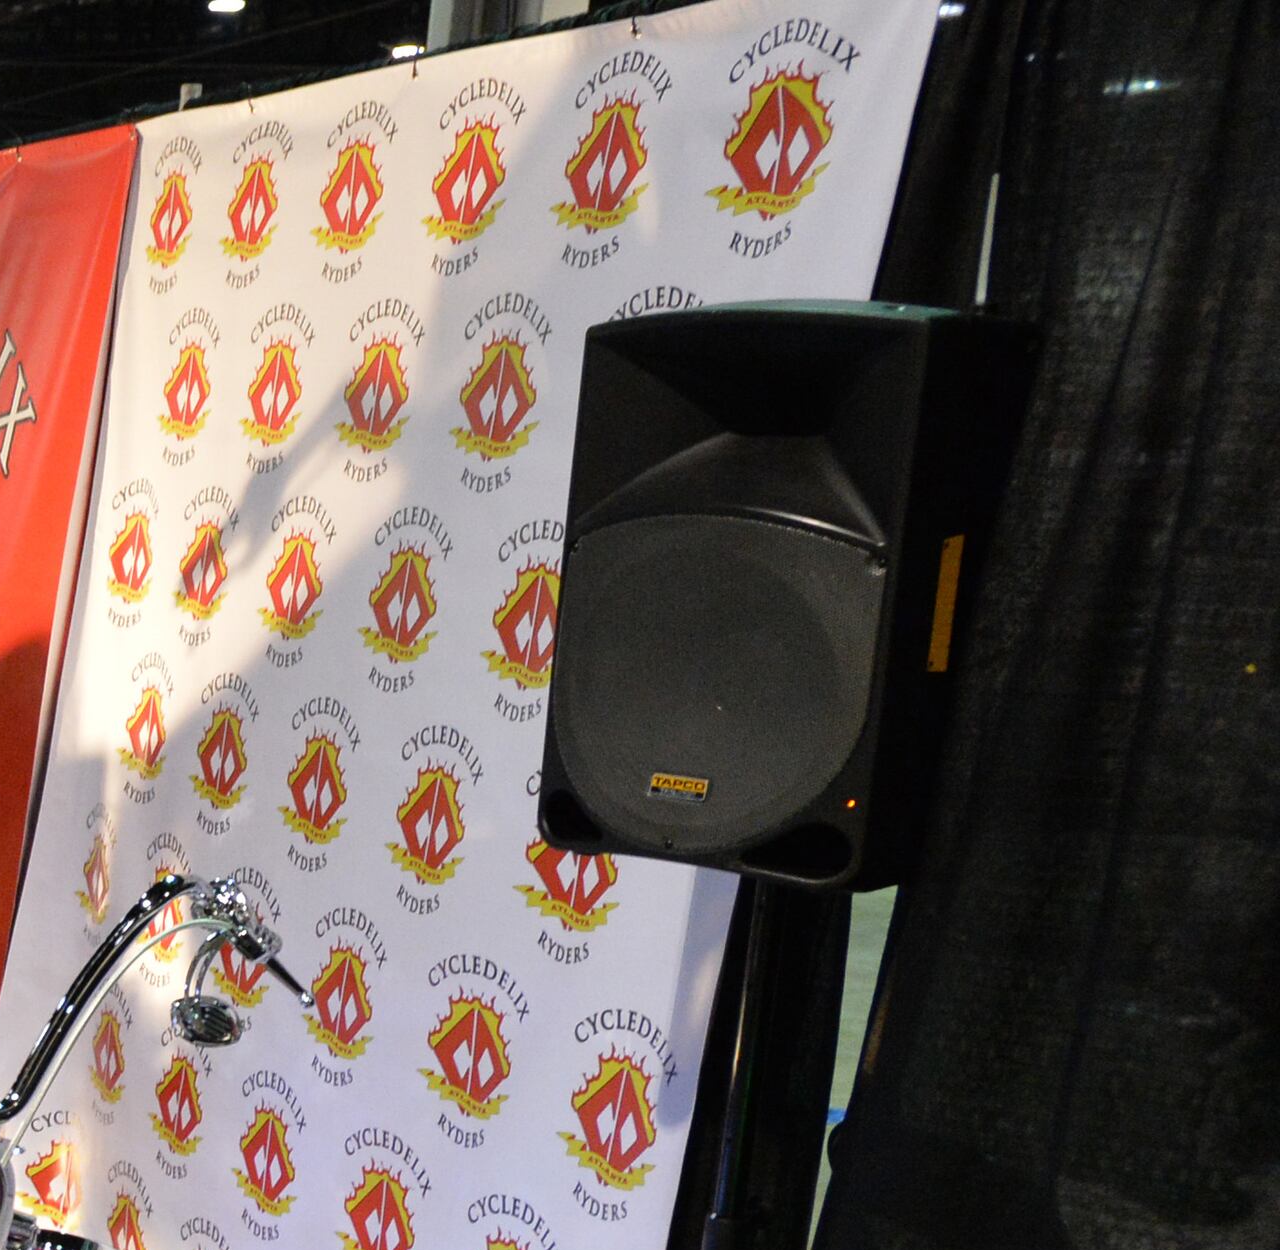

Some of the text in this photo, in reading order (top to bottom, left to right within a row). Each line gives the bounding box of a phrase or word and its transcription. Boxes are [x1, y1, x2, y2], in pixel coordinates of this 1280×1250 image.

[729, 18, 860, 84] CYCLEDELIX
[575, 51, 672, 112] CYCLEDELIX
[440, 78, 526, 130] CYCLEDELIX
[233, 121, 293, 163] CYCLEDELIX
[327, 101, 398, 148] CYCLEDELIX
[744, 196, 797, 207] ATLANTA
[562, 236, 619, 268] RYDERS
[729, 221, 791, 258] RYDERS
[322, 258, 361, 283] RYDERS
[432, 247, 478, 277] RYDERS
[170, 308, 219, 347] CYCLEDELIX
[251, 304, 315, 348] CYCLEDELIX
[349, 299, 426, 348] CYCLEDELIX
[465, 293, 554, 344] CYCLEDELIX
[247, 452, 284, 474] RYDERS
[344, 458, 387, 482] RYDERS
[461, 466, 511, 493] RYDERS
[184, 486, 240, 531] CYCLEDELIX
[271, 495, 337, 545] CYCLEDELIX
[374, 506, 454, 561] CYCLEDELIX
[266, 645, 304, 670] RYDERS
[369, 667, 414, 693] RYDERS
[201, 673, 259, 724] CYCLEDELIX
[494, 693, 541, 722] RYDERS
[292, 697, 360, 753] CYCLEDELIX
[402, 725, 484, 787] CYCLEDELIX
[124, 781, 155, 804] RYDERS
[653, 776, 706, 791] TAPCO
[197, 808, 230, 835] RYDERS
[288, 844, 327, 872] RYDERS
[396, 885, 439, 915] RYDERS
[551, 903, 591, 927] ATLANTA
[315, 907, 387, 970] CYCLEDELIX
[538, 931, 589, 964] RYDERS
[428, 954, 530, 1024] CYCLEDELIX
[575, 1009, 678, 1086] CYCLEDELIX
[312, 1052, 353, 1086] RYDERS
[242, 1070, 306, 1136] CYCLEDELIX
[449, 1087, 488, 1113] ATLANTA
[438, 1112, 484, 1148] RYDERS
[345, 1128, 431, 1199] CYCLEDELIX
[587, 1154, 628, 1186] ATLANTA
[573, 1180, 627, 1221] RYDERS
[242, 1208, 279, 1240] RYDERS
